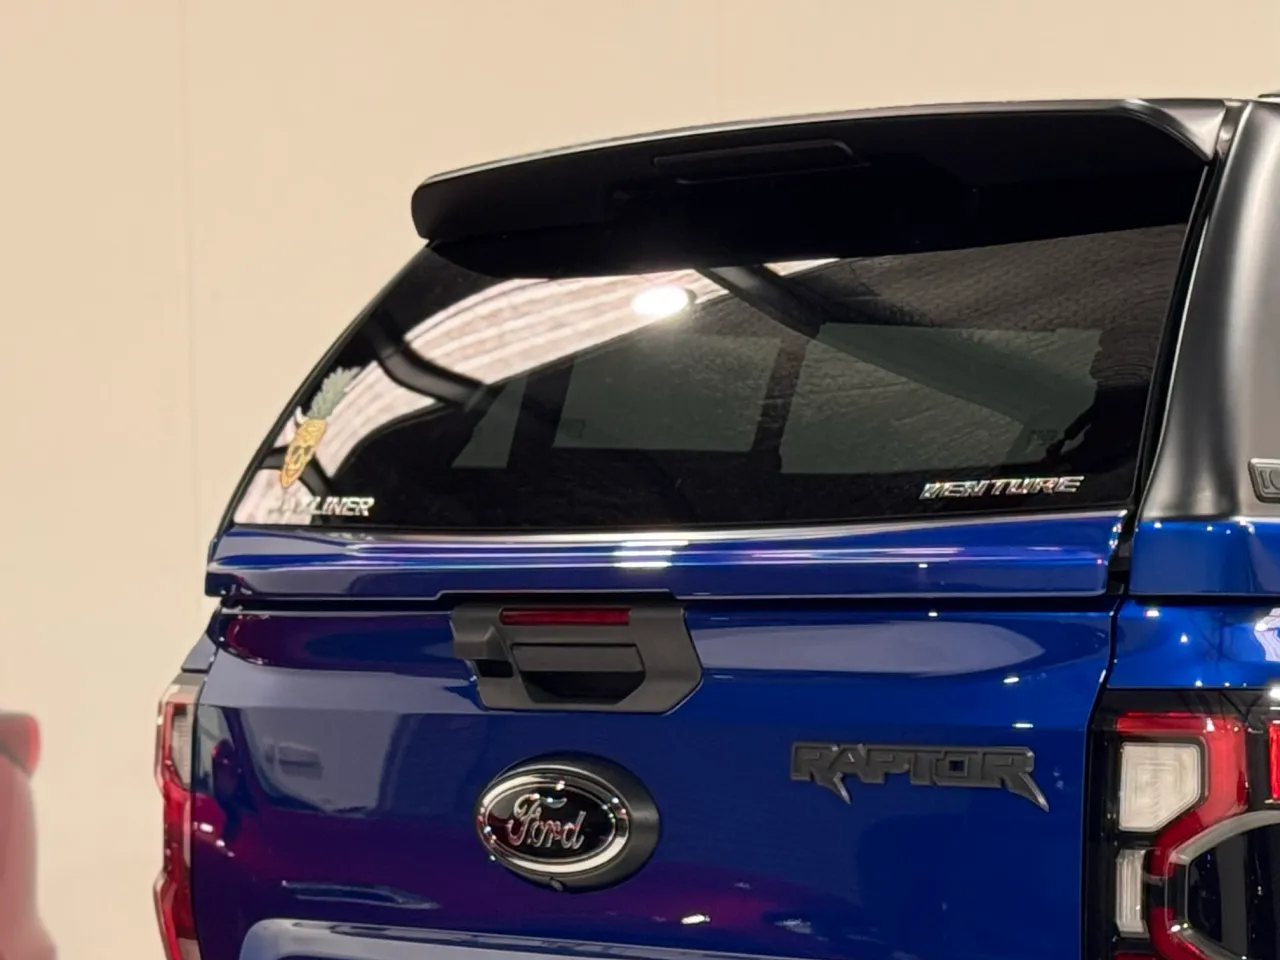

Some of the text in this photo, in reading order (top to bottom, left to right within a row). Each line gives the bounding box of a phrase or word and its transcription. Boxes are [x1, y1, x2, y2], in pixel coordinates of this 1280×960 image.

[919, 475, 1085, 500] VENTURE
[790, 741, 1049, 812] RAPTOR
[506, 793, 587, 850] Ford
